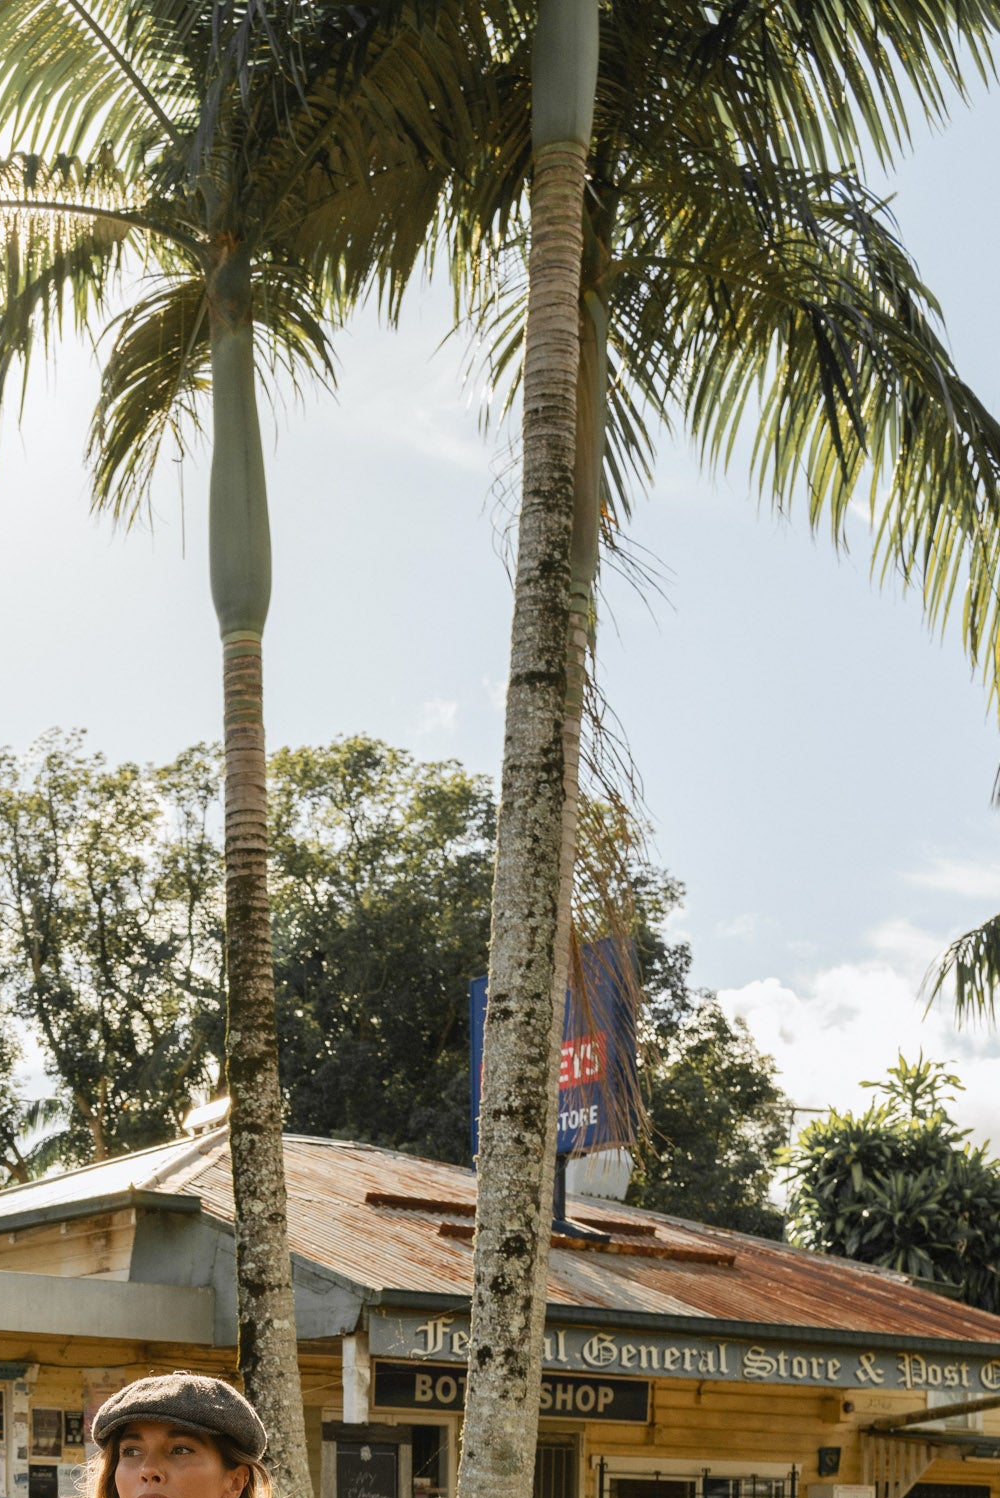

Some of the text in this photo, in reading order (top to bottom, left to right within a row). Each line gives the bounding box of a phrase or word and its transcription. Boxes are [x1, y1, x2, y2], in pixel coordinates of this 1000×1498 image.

[557, 1105, 598, 1131] TORE
[410, 1317, 568, 1362] Feal
[581, 1332, 730, 1374] General
[742, 1345, 841, 1380] Store
[855, 1352, 885, 1384] &
[897, 1352, 972, 1390] Post
[539, 1382, 615, 1413] SHOP
